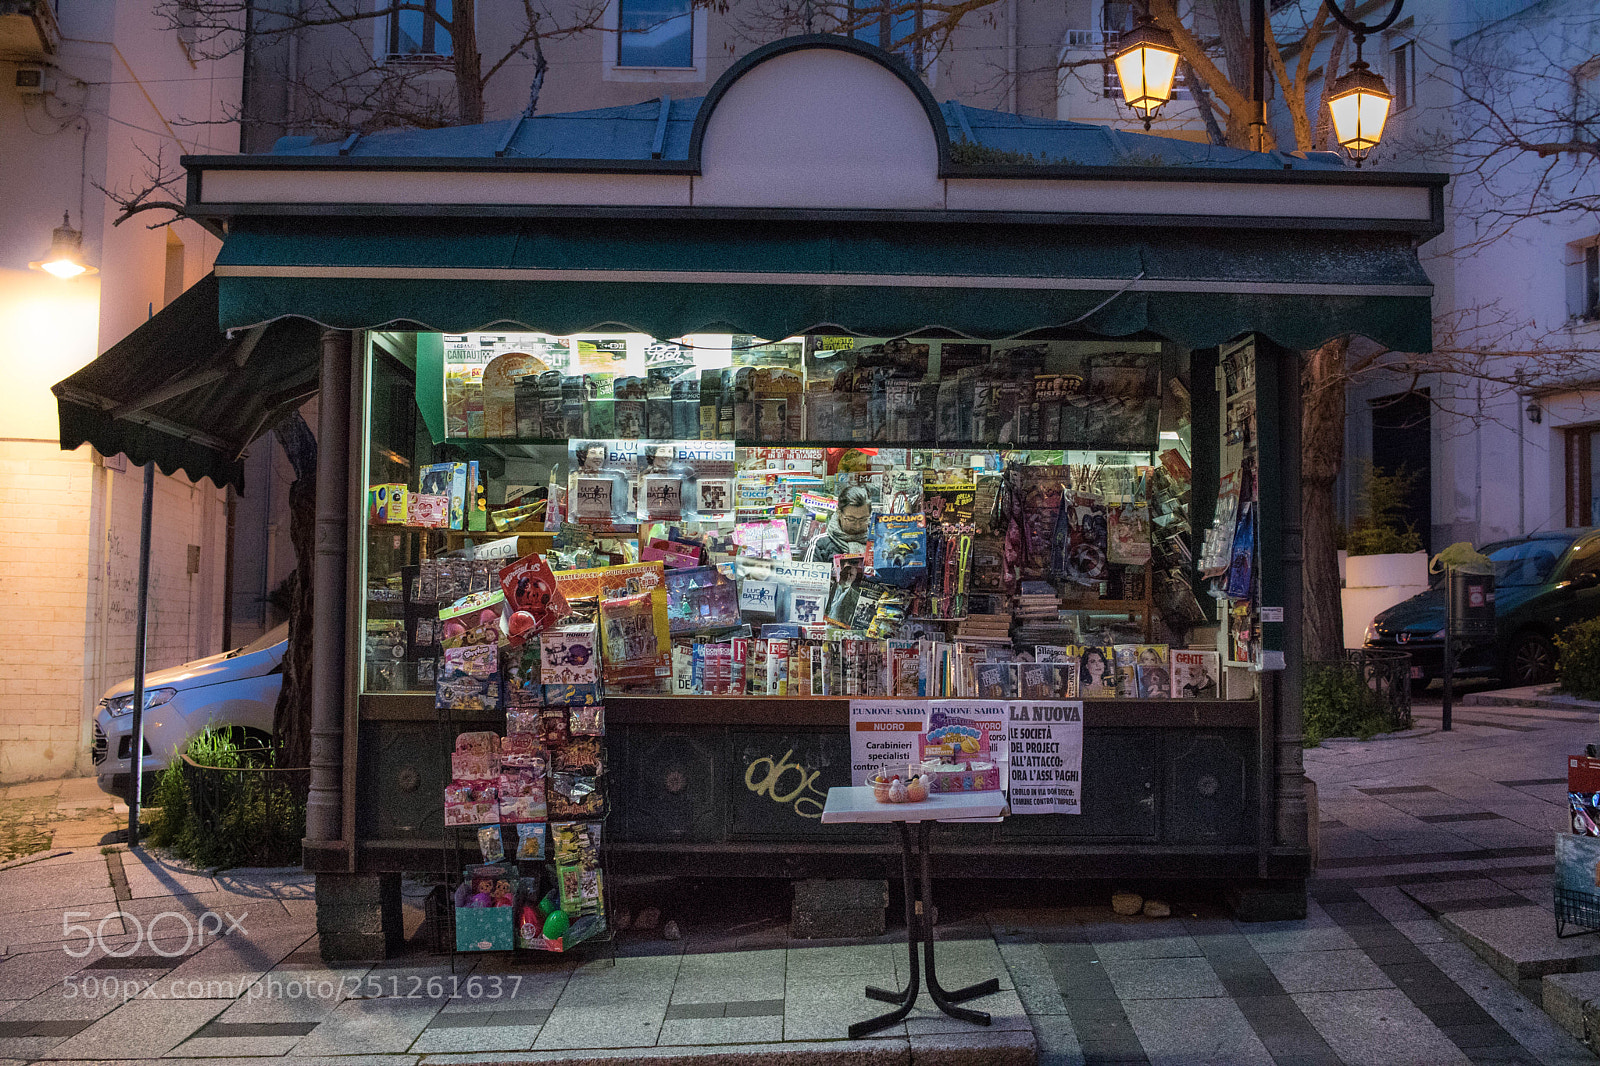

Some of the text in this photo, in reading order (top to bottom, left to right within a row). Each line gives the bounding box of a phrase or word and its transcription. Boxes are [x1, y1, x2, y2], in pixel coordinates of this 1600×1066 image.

[678, 451, 735, 461] BATTISTI
[877, 514, 925, 523] TOPOLINO
[782, 560, 826, 570] LUCIO
[503, 562, 541, 588] Miraculus
[776, 567, 831, 579] BATTISTI
[1176, 653, 1204, 665] GENTE
[932, 707, 971, 715] L'UNIONE
[1009, 706, 1081, 722] LA NUOVA
[873, 723, 905, 732] NUORO
[1010, 725, 1052, 739] LE SOCIETÀ
[866, 741, 913, 750] Carabinieri
[1011, 742, 1060, 754] DEL PROJECT
[868, 753, 910, 763] specialisti
[1011, 755, 1064, 768] ALL'ATTACCO:
[853, 762, 879, 771] contro
[1012, 769, 1079, 782] ORA L'ASSL PAGHI
[1012, 788, 1030, 796] CROLLO
[1031, 788, 1037, 796] IN
[1038, 788, 1046, 796] VIA
[1033, 797, 1054, 806] CONTRO
